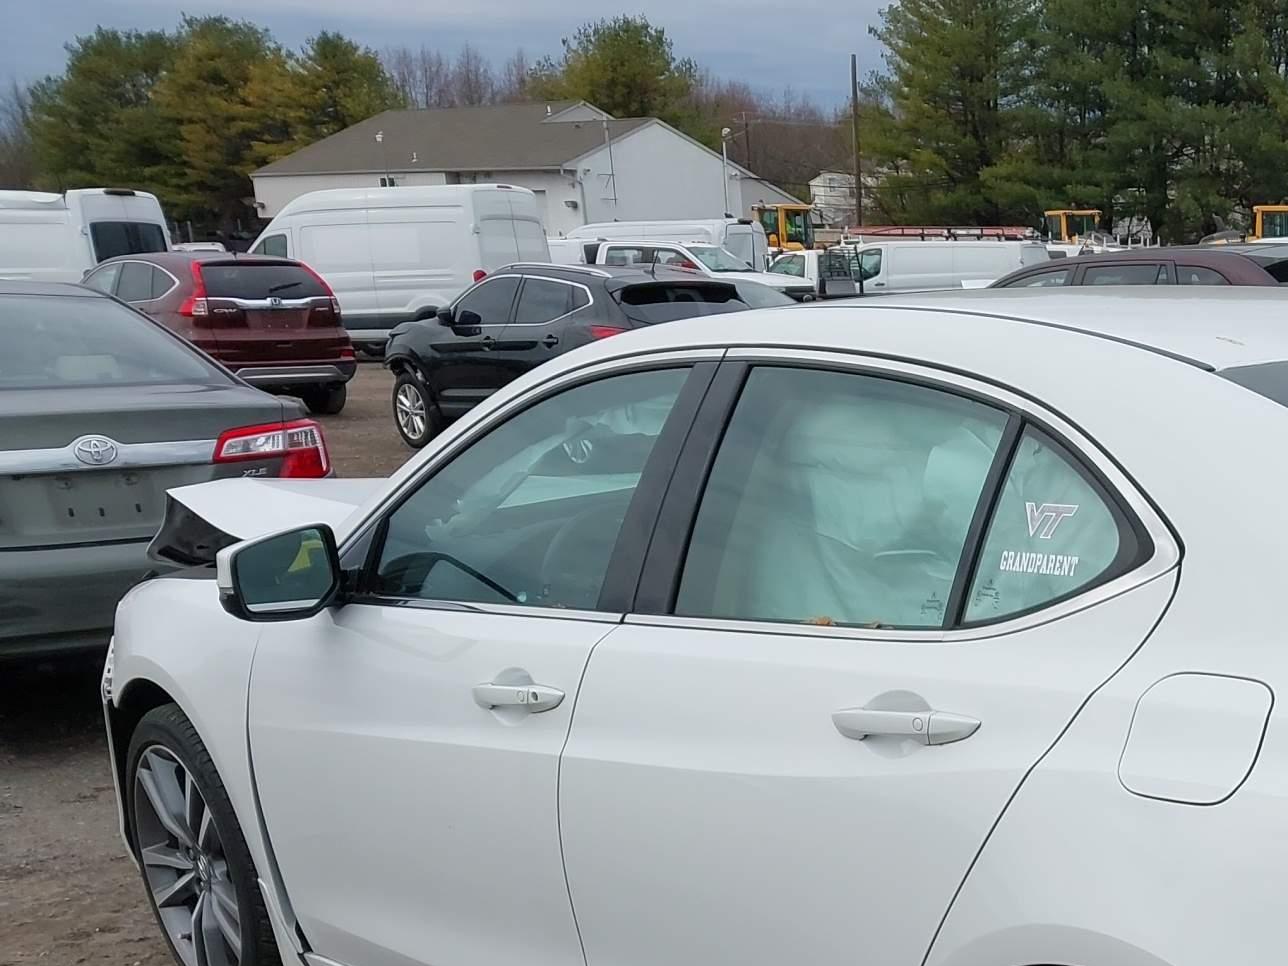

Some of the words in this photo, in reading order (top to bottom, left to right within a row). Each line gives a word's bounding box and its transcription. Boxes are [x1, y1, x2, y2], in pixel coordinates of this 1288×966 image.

[242, 467, 267, 477] XLE
[1025, 501, 1080, 539] VT
[1000, 549, 1080, 577] GRANDPARENT
